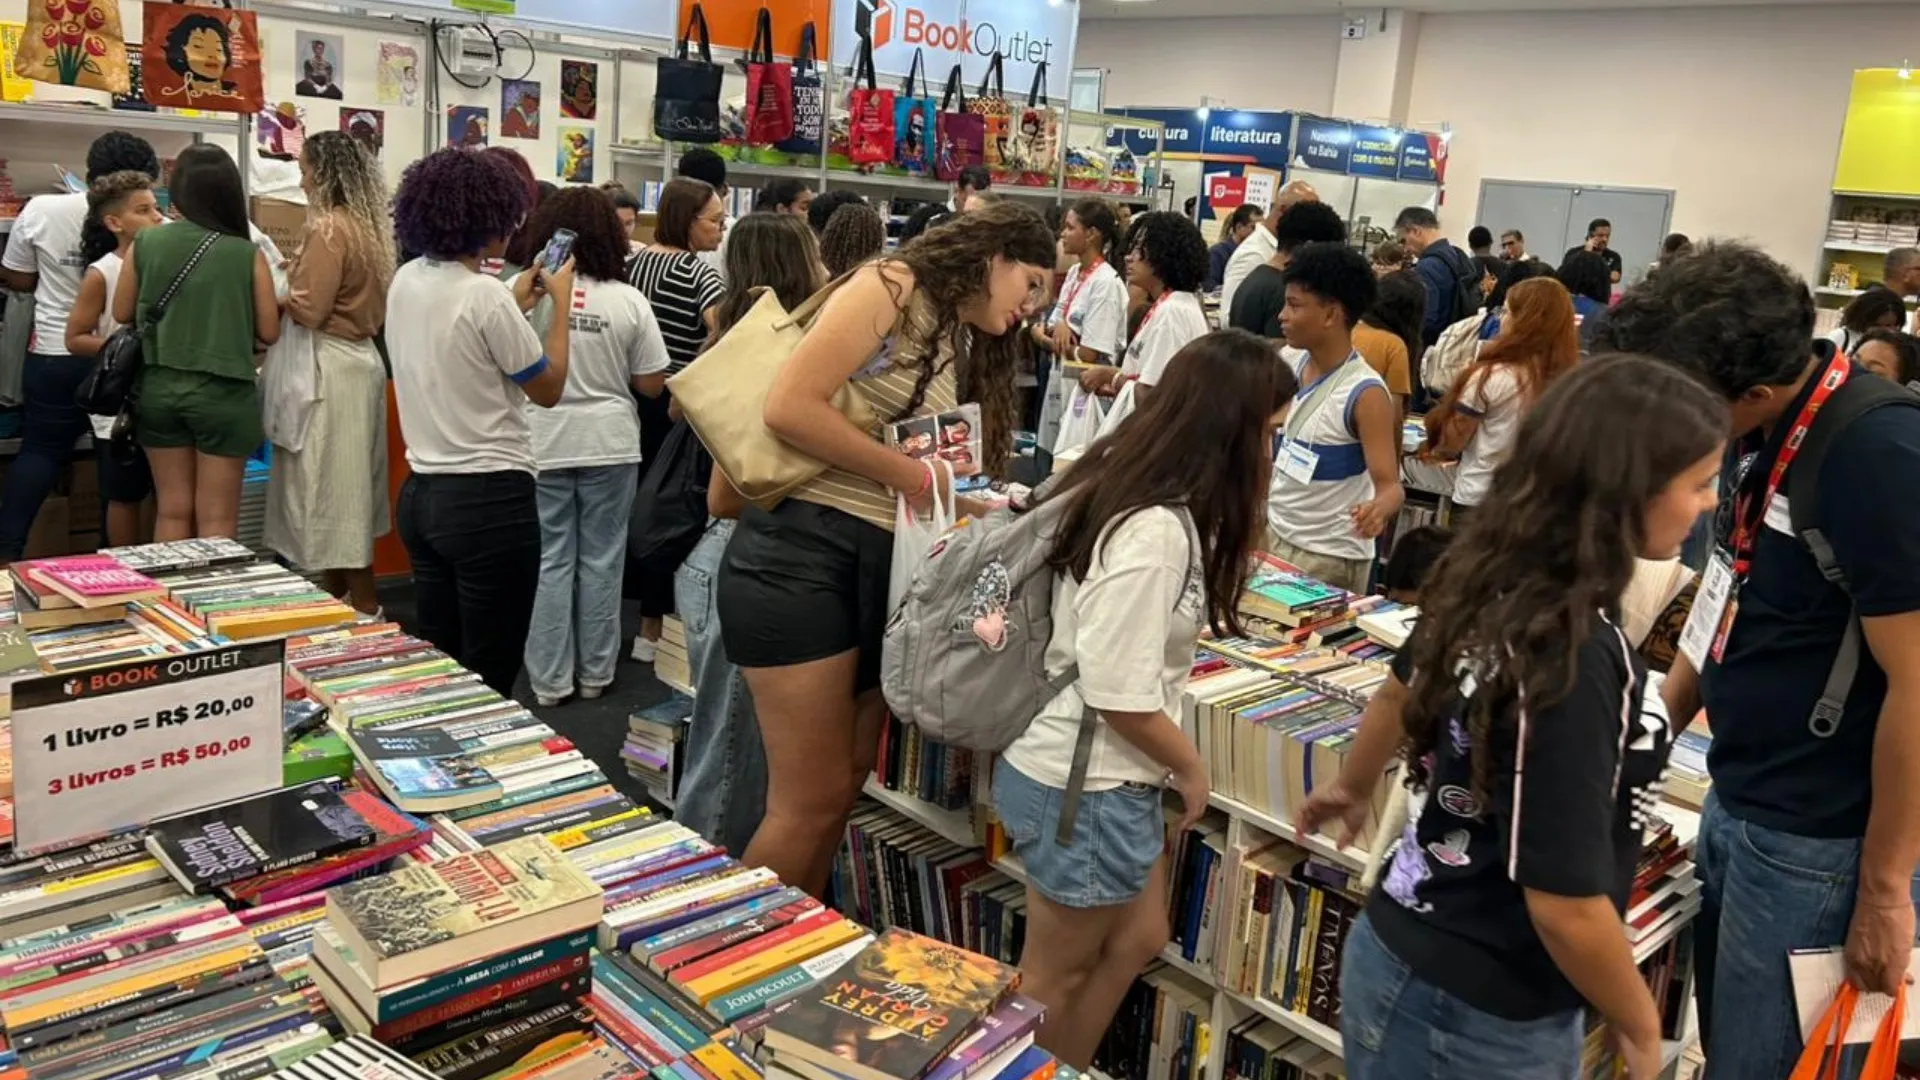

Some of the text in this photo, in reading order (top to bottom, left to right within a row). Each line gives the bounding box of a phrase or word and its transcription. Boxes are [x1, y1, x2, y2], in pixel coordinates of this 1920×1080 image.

[1138, 127, 1189, 140] culura
[1211, 126, 1282, 144] literatura
[90, 650, 241, 690] BOOK OUTLET
[43, 695, 254, 752] 1 livro = R$ 20,00
[48, 736, 251, 795] 3 livros = R$ 50,00
[178, 836, 228, 878] Sidney
[202, 820, 257, 870] Sheldon
[465, 969, 490, 984] MESA
[517, 949, 544, 965] VALOR
[726, 971, 806, 1009] JODI PICOULT
[838, 980, 948, 1028] CARLAN
[823, 991, 941, 1038] AUDREY
